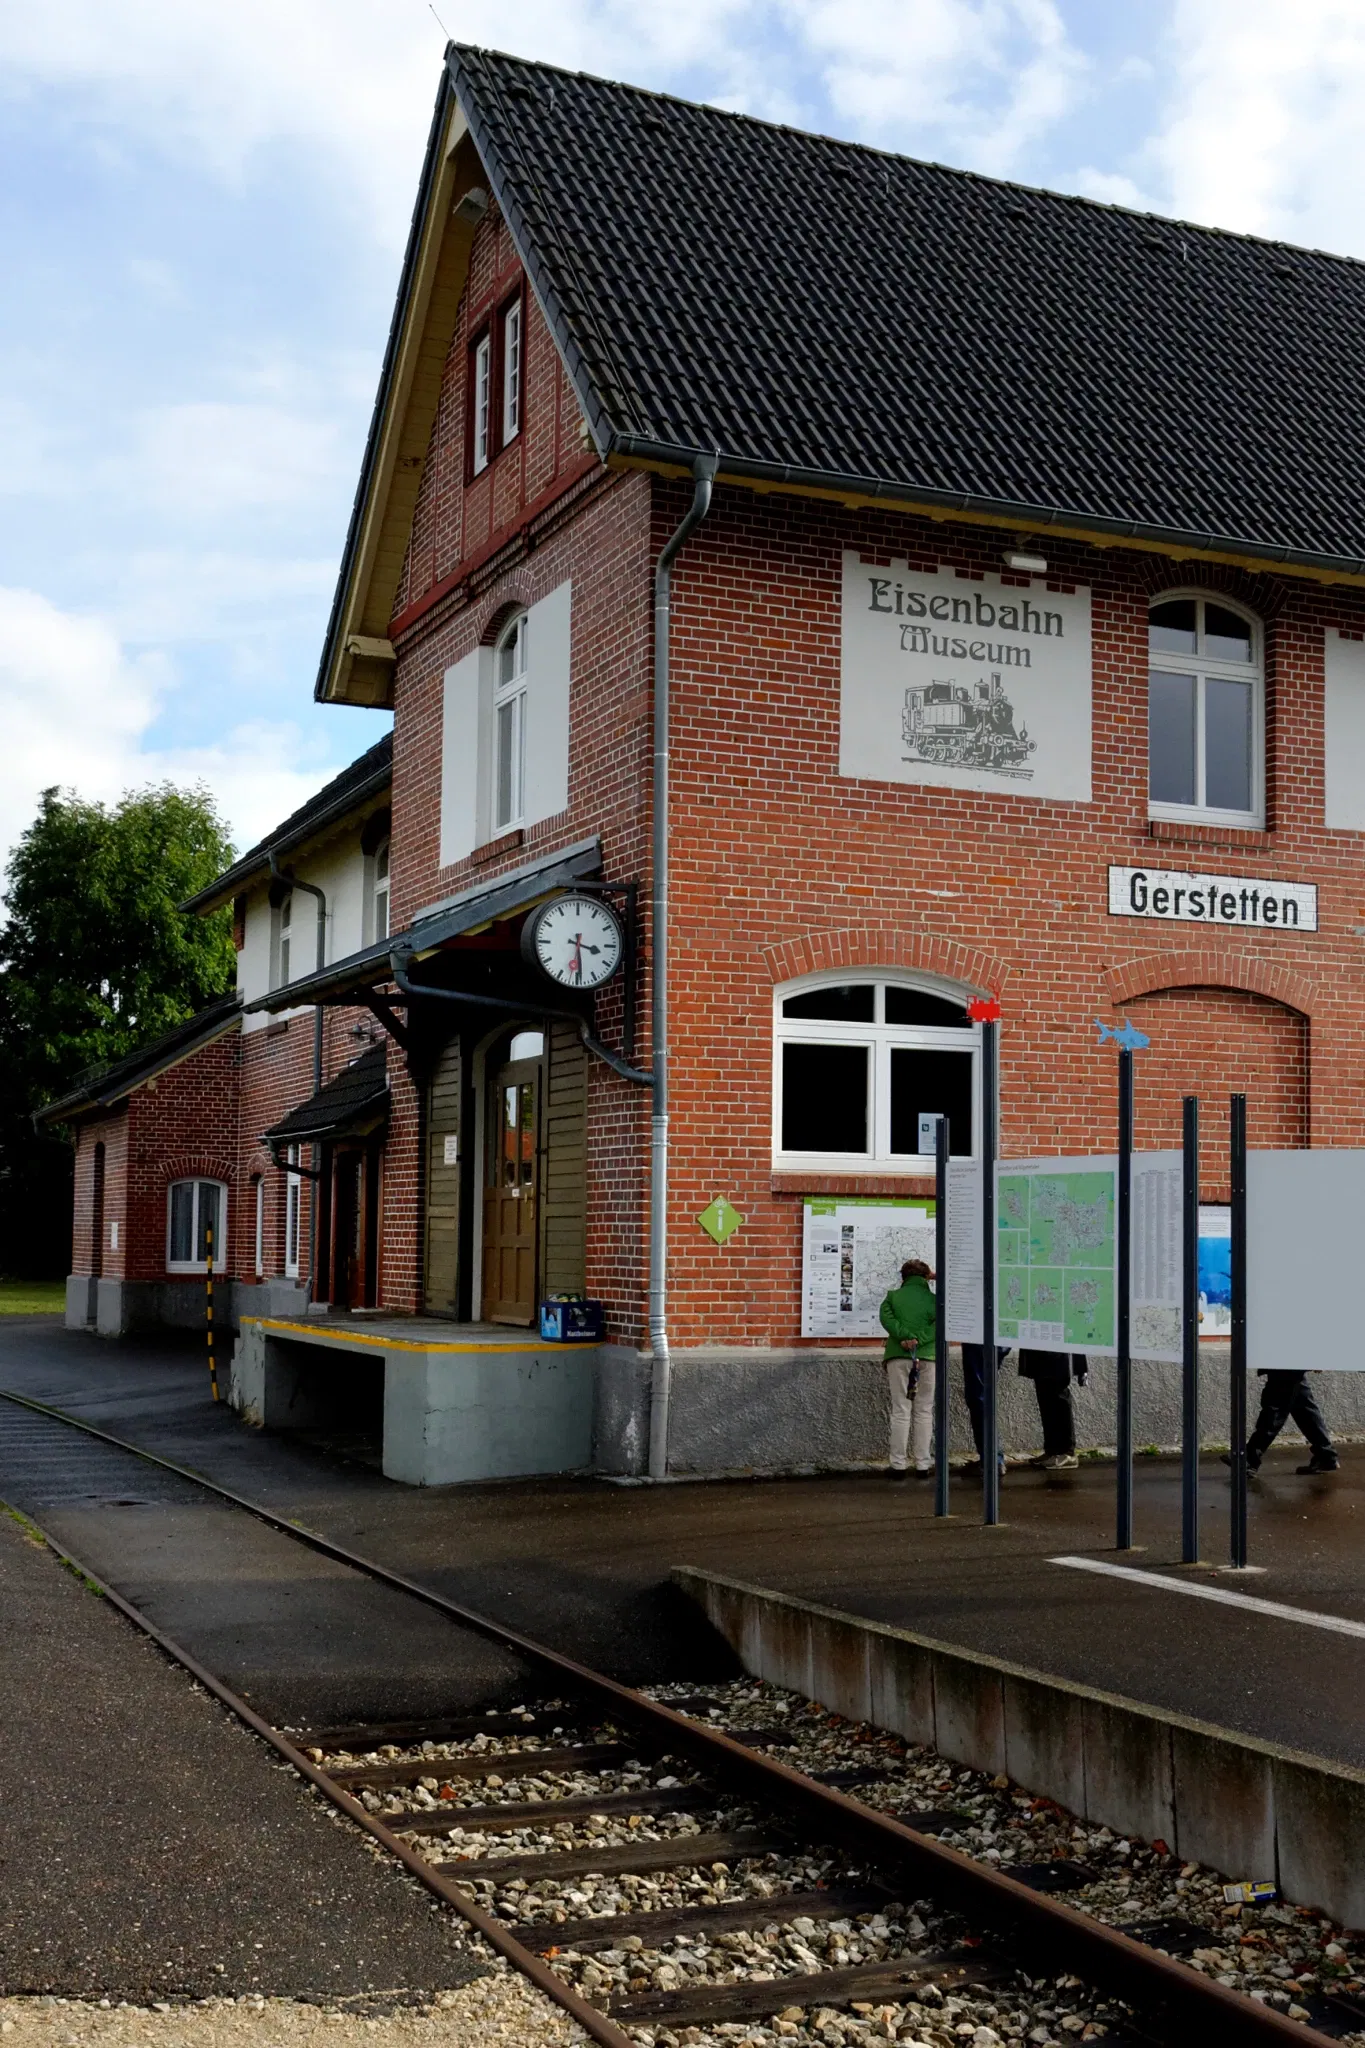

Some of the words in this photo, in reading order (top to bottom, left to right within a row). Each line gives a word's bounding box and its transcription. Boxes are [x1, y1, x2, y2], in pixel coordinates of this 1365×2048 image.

[868, 578, 1065, 637] Eisenbahn
[899, 624, 1032, 668] Museum
[1130, 872, 1299, 925] Gerstetten
